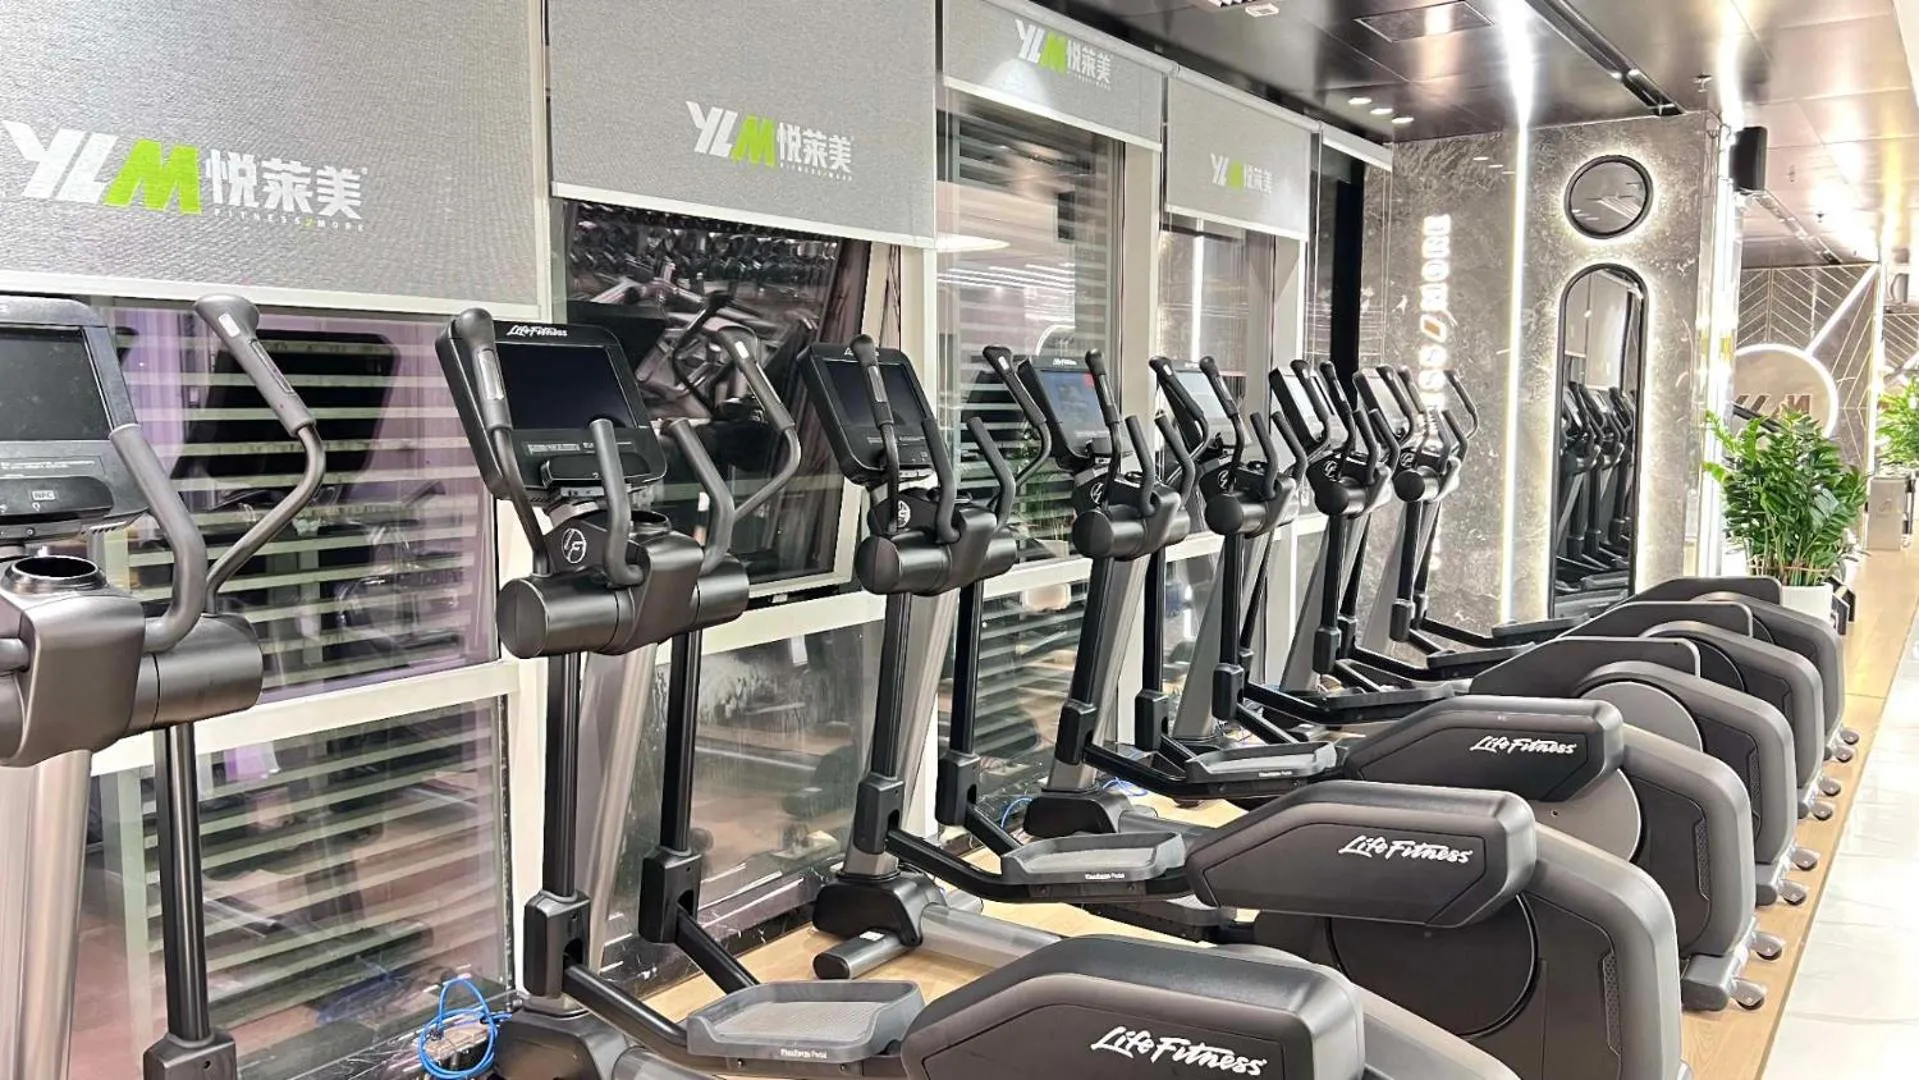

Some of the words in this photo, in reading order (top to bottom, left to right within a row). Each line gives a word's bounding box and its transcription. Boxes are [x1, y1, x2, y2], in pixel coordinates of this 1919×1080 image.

[3, 119, 202, 215] YLM
[686, 100, 776, 168] YLM
[777, 122, 852, 173] 悦莱美
[205, 149, 363, 219] 悦莱美
